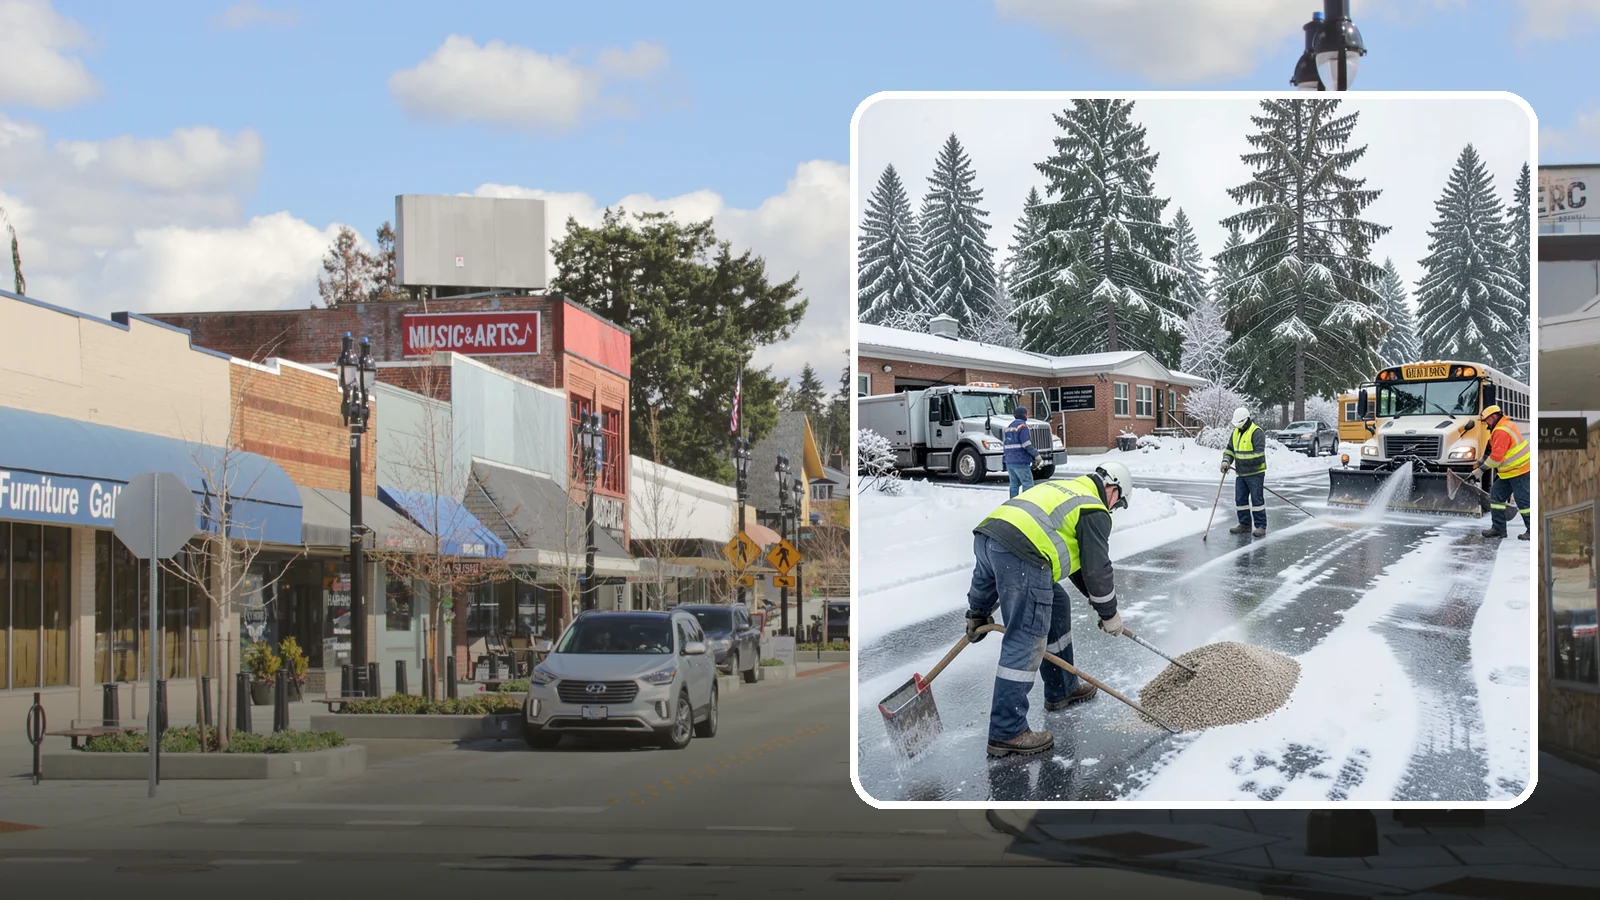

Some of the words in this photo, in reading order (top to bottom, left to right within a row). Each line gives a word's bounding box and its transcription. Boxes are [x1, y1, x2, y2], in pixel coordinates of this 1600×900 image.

[409, 323, 520, 348] MUSIC&ARTS
[0, 471, 79, 515] Furniture
[89, 482, 122, 519] Gal
[453, 563, 480, 574] SUSHI
